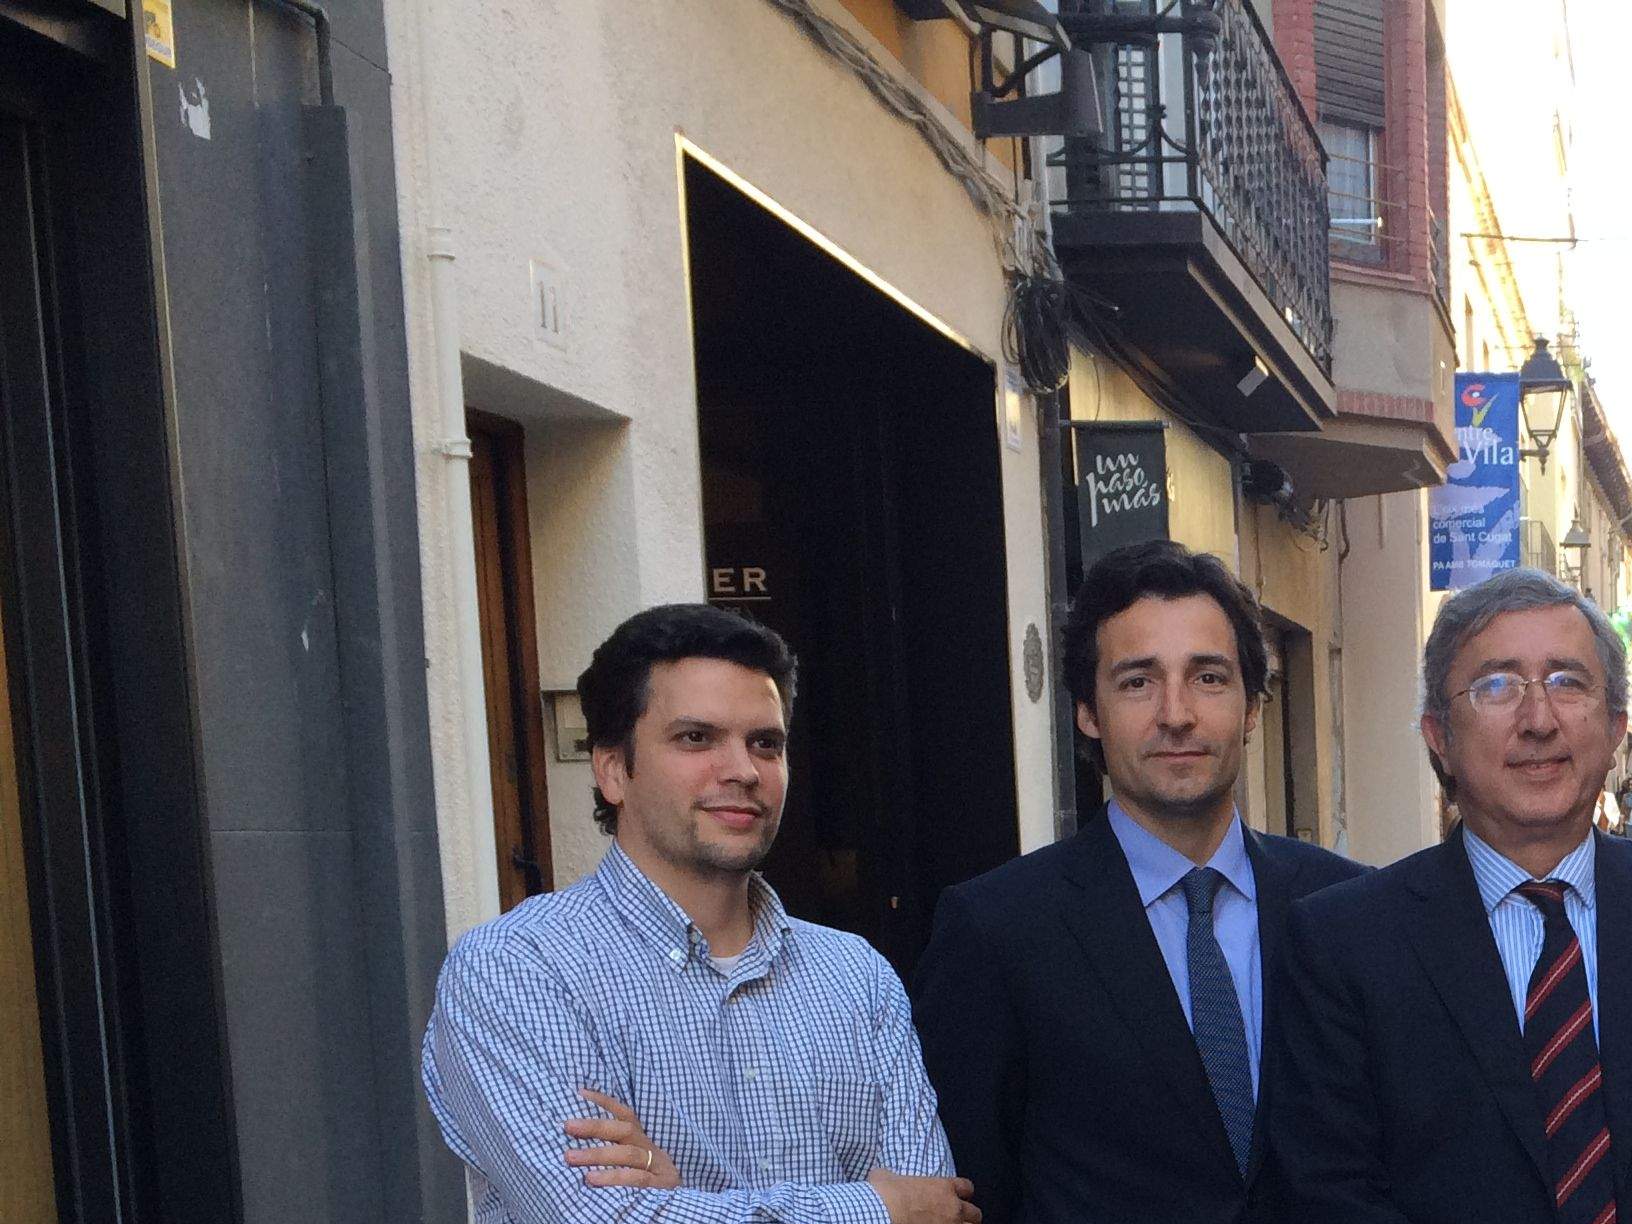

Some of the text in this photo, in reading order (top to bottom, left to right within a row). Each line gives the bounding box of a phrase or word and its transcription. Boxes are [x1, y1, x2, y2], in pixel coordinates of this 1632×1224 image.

[1462, 438, 1514, 465] Vila
[1096, 453, 1139, 475] un
[1086, 467, 1145, 527] paso
[1433, 518, 1486, 529] comercial
[1433, 531, 1512, 546] de Sant Cugat
